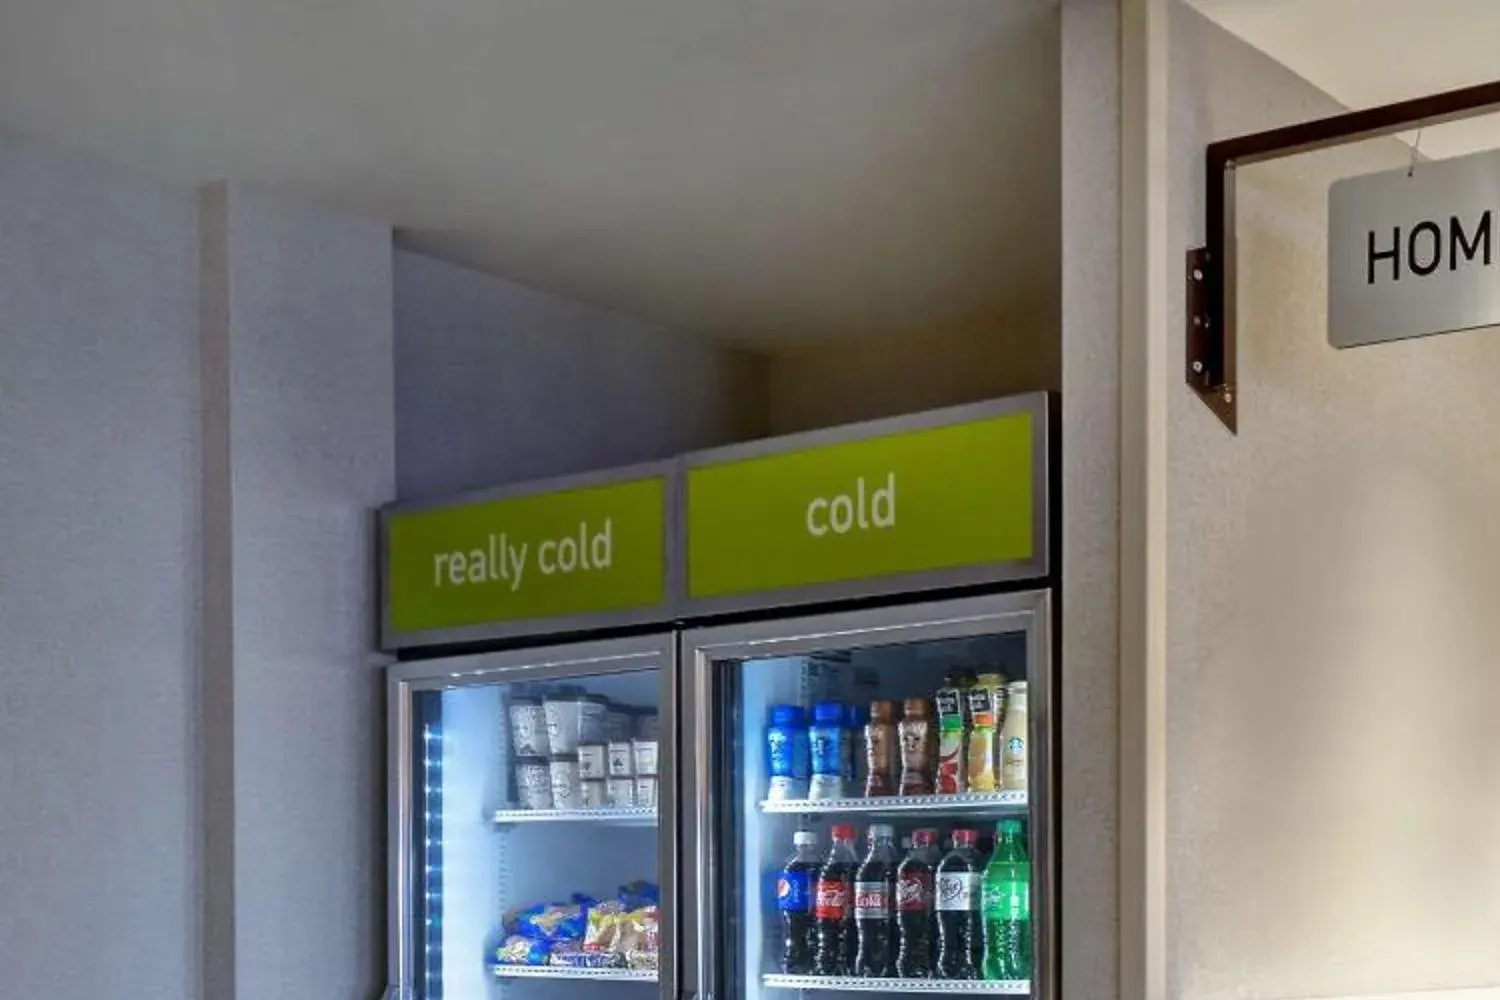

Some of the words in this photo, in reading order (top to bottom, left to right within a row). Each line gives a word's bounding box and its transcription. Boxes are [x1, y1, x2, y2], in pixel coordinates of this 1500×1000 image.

[806, 472, 896, 537] cold
[433, 532, 527, 592] really
[537, 518, 613, 575] cold
